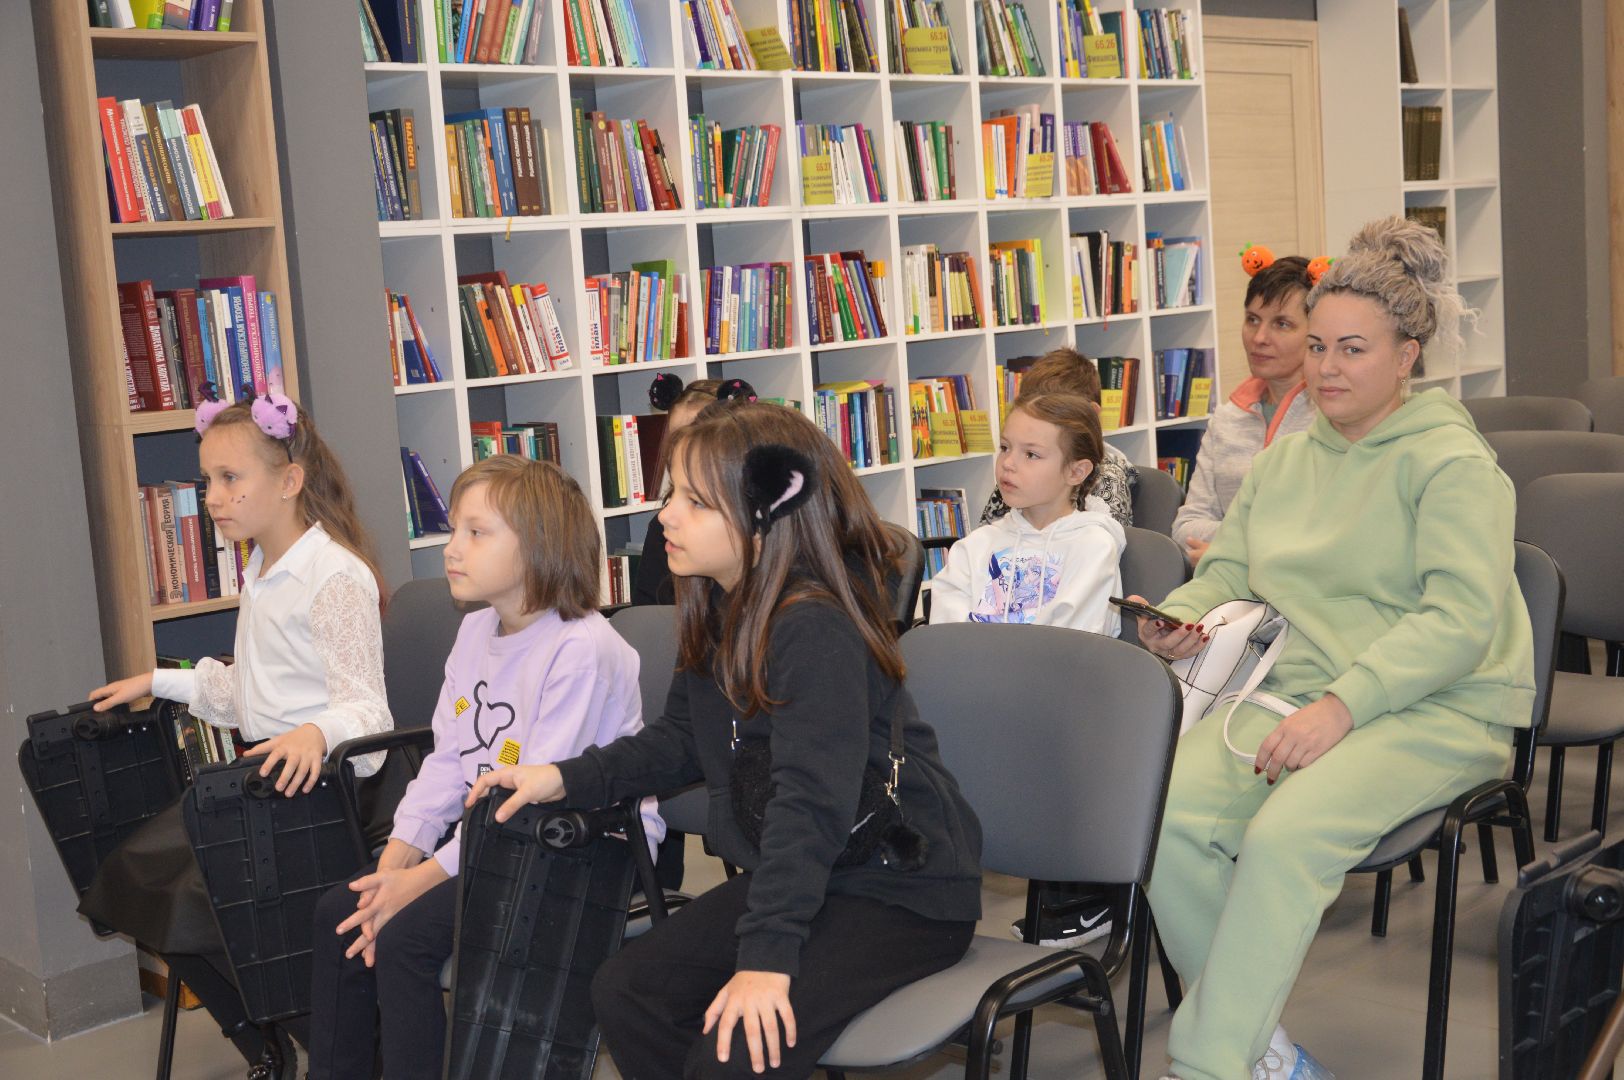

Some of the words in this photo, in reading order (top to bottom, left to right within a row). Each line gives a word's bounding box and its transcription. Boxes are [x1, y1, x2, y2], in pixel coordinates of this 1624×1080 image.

[171, 138, 180, 161] ТЕОРИЯ
[405, 121, 416, 168] НАЛОГИ
[141, 139, 165, 214] МИКРОЭКОНОМИКА
[176, 162, 194, 215] ЭКОНОМИЧЕСКАЯ
[233, 296, 244, 322] ТЕОРИЯ
[238, 324, 251, 382] ЭКОНОМИЧЕСКАЯ
[161, 497, 175, 531] ТЕОРИЯ
[167, 529, 182, 599] ЭКОНОМИЧЕСКАЯ
